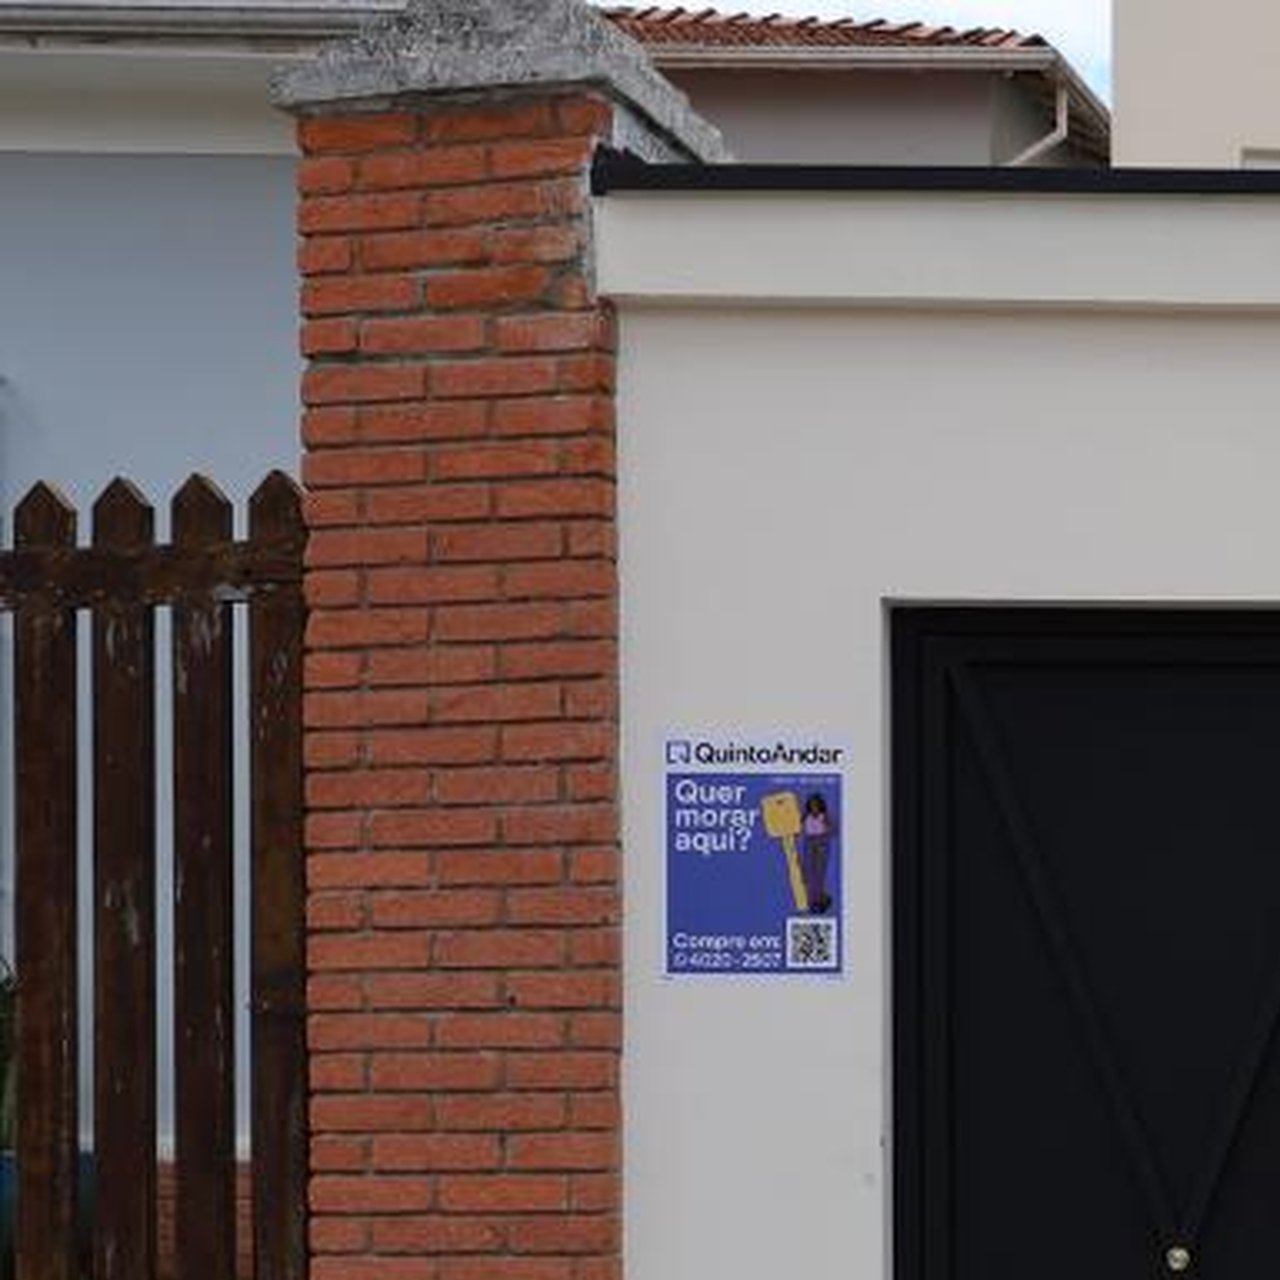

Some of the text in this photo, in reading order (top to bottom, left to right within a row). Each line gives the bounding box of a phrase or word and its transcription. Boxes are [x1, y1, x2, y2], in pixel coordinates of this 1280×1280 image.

[695, 742, 843, 764] QuintoAndar
[676, 780, 746, 804] Quer
[676, 809, 757, 827] morar
[675, 828, 751, 856] aqui?
[673, 933, 747, 950] Compre
